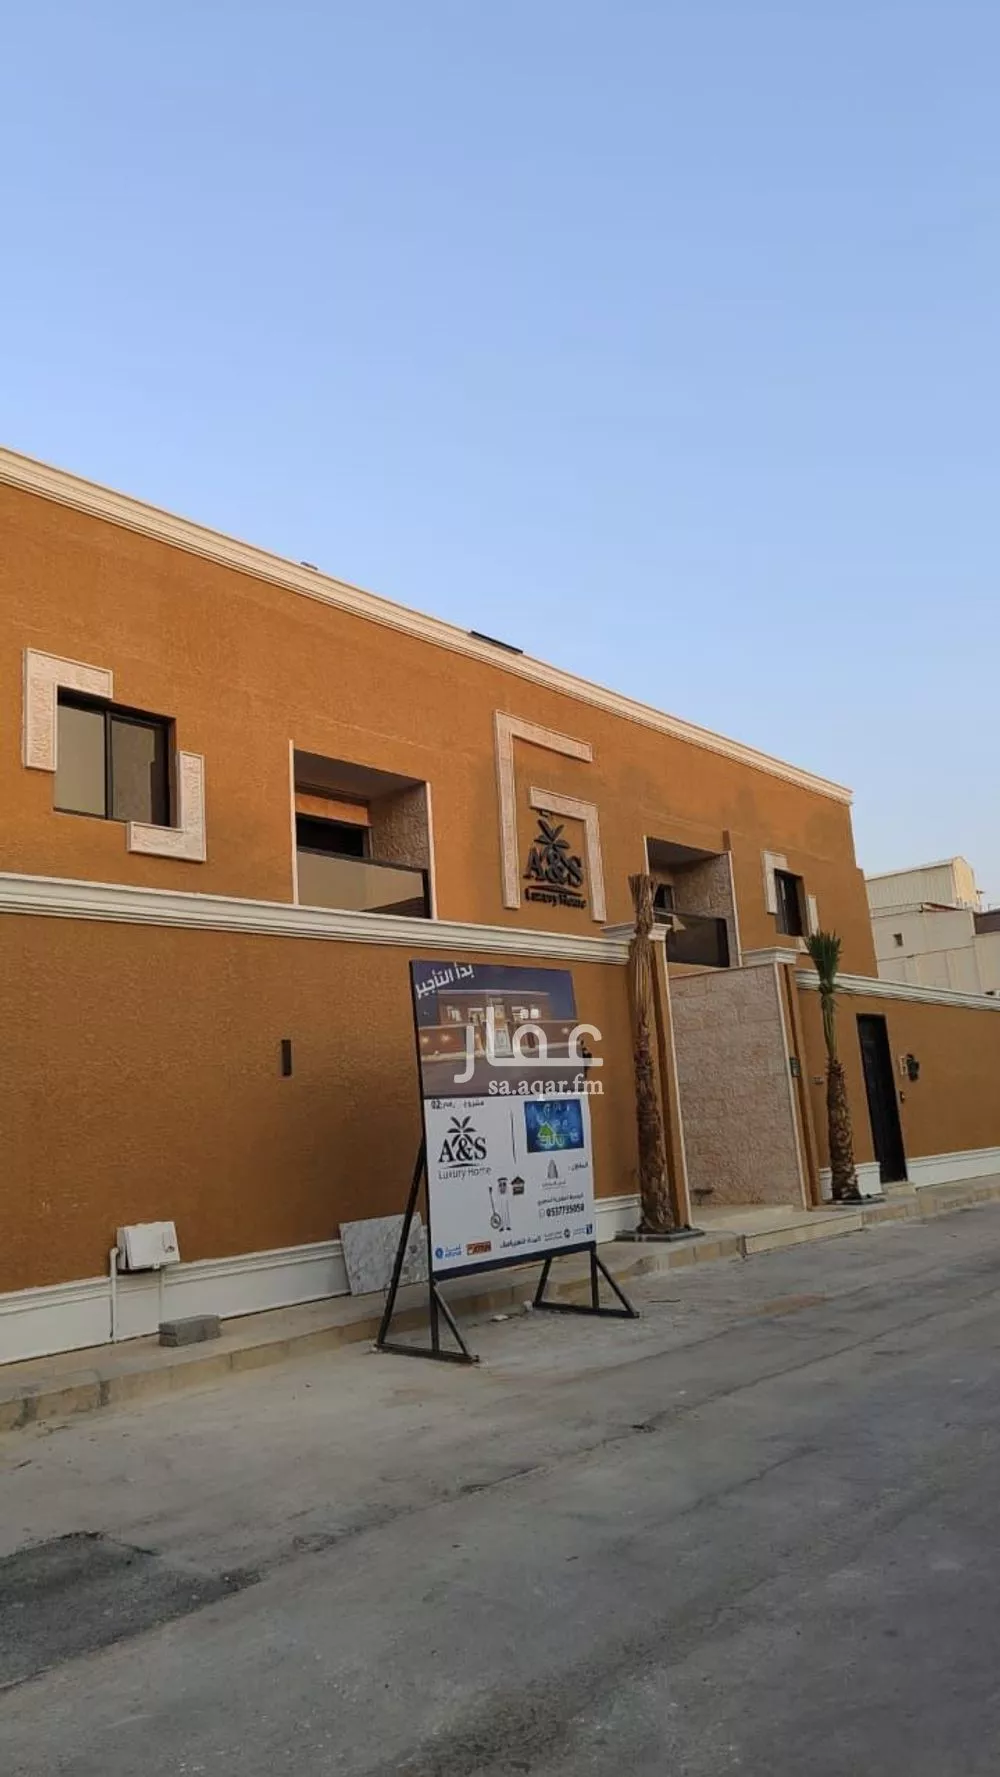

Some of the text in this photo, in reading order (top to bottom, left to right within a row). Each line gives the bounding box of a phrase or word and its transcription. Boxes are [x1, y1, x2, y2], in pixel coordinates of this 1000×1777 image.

[523, 847, 584, 888] A&S
[415, 961, 476, 1000] بدأ التأجير
[438, 1136, 487, 1163] A&S
[438, 1169, 466, 1181] Luxury
